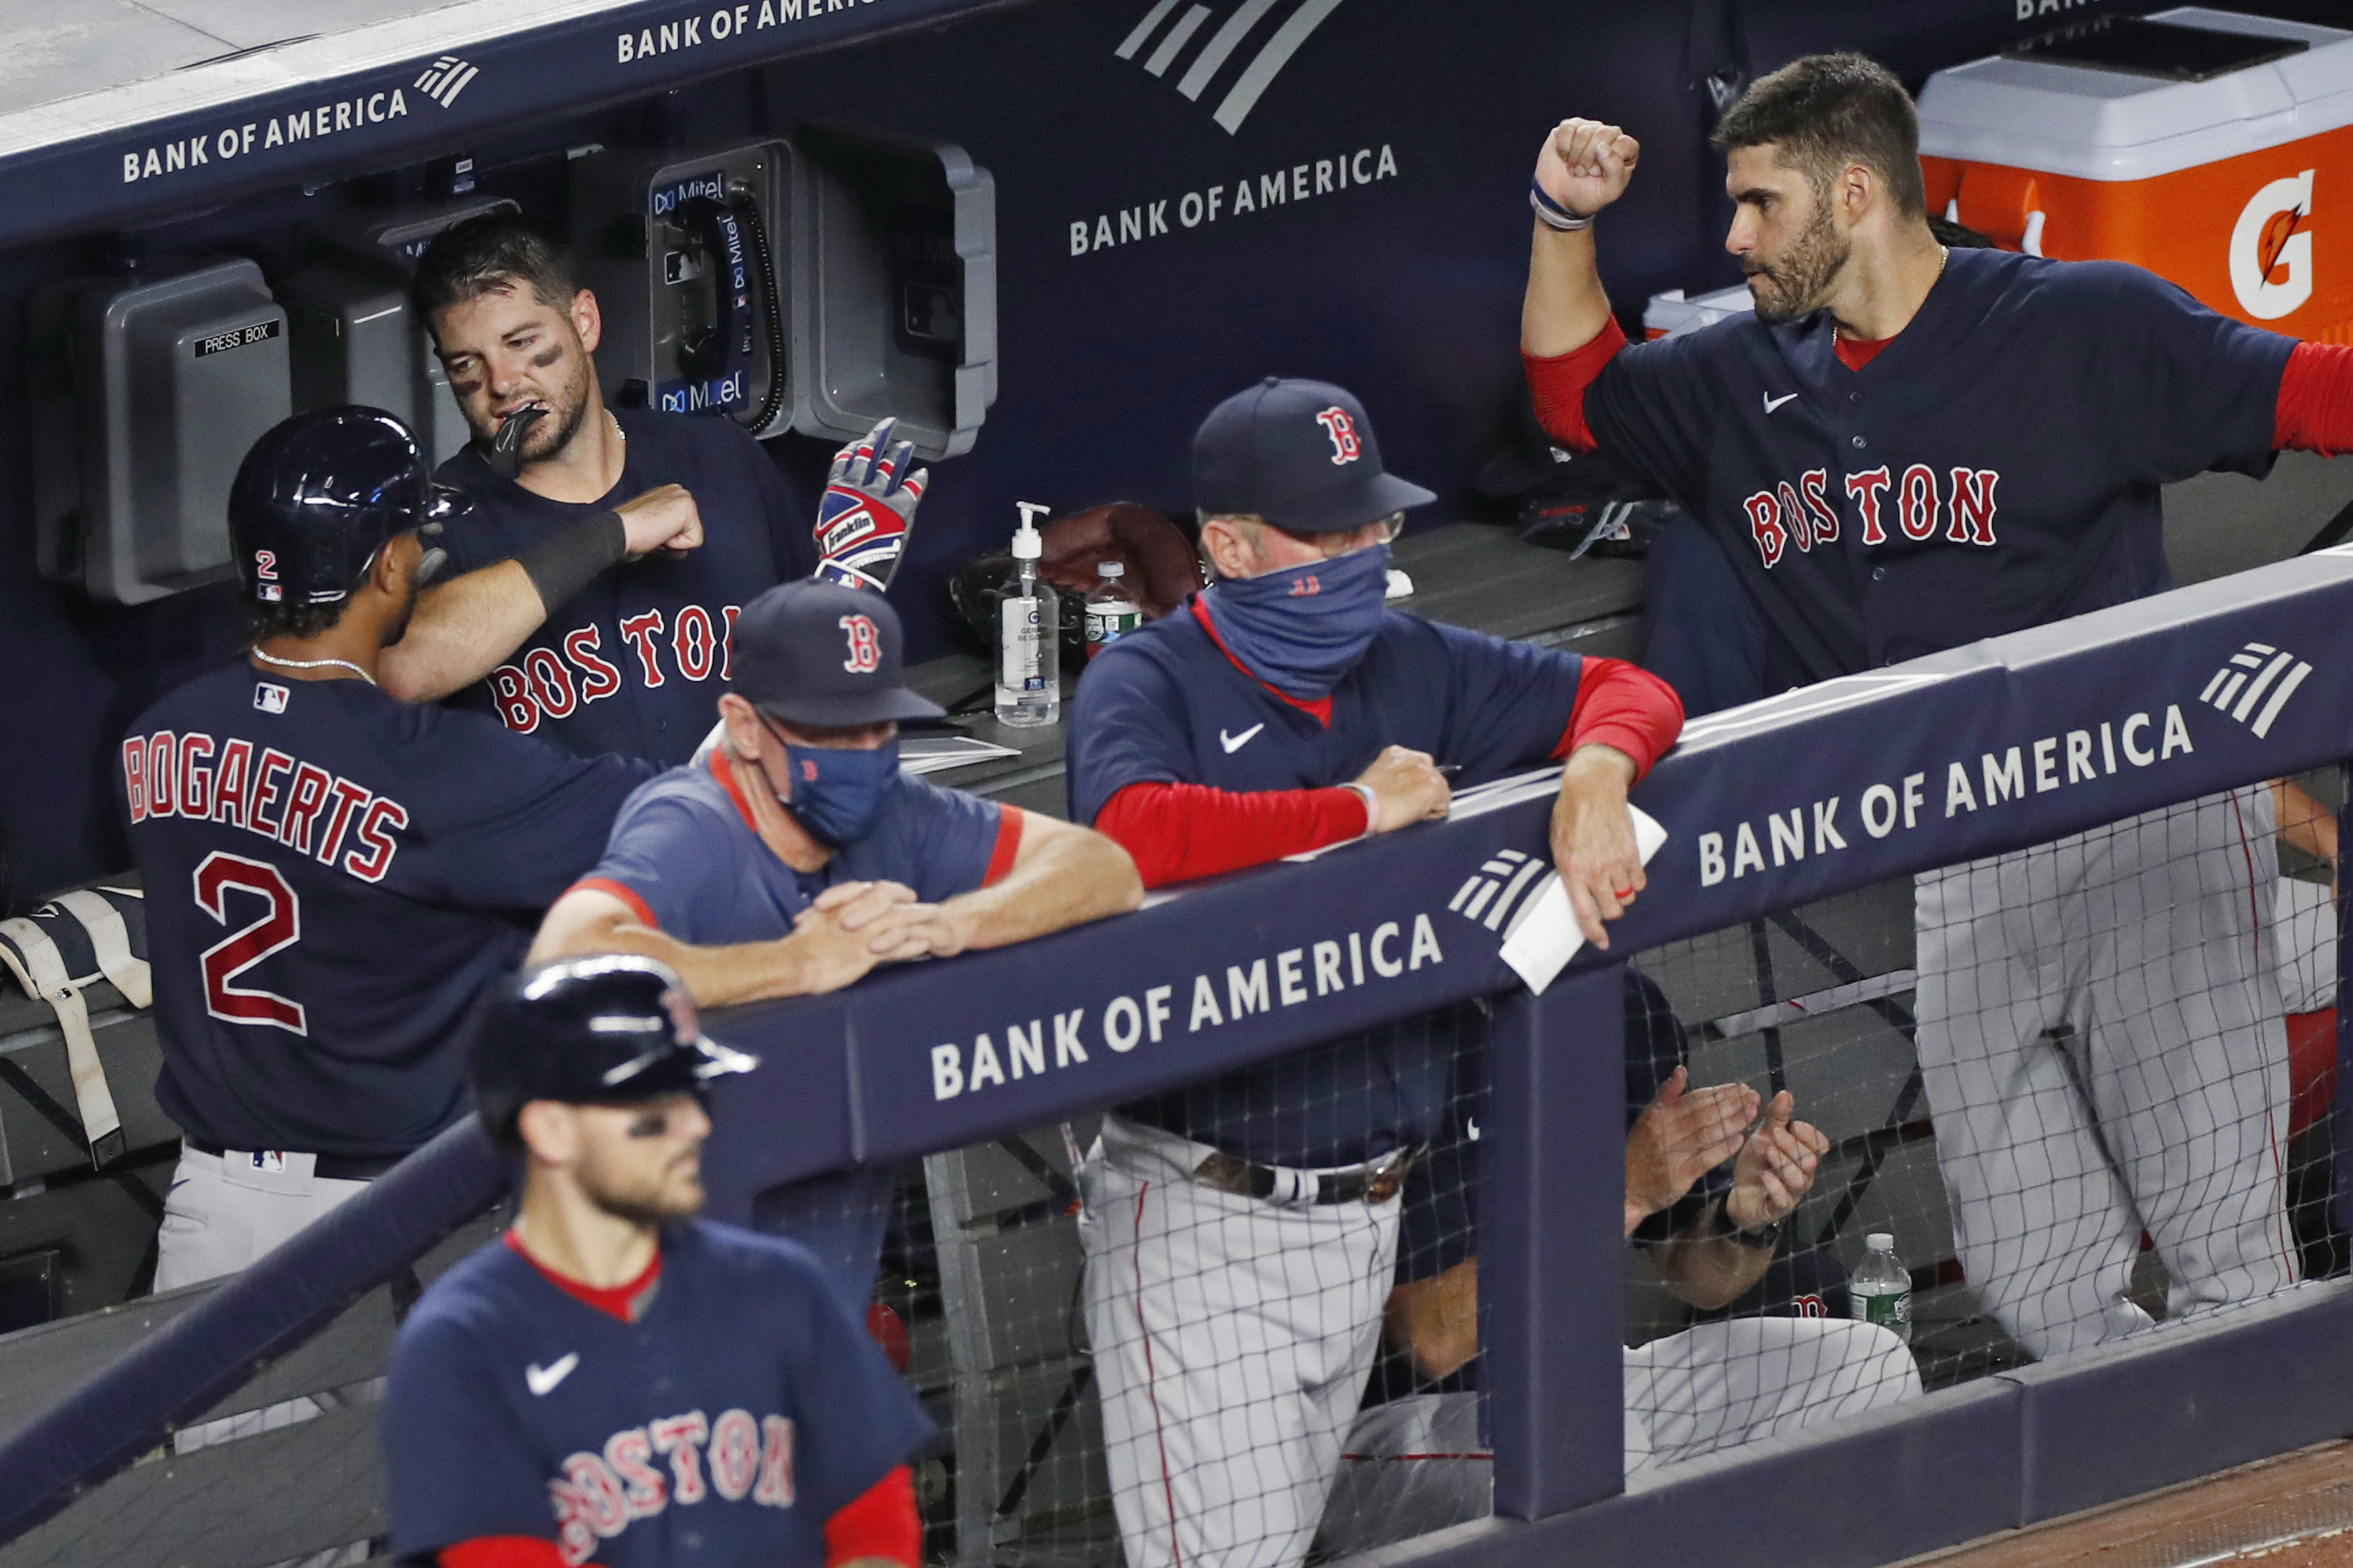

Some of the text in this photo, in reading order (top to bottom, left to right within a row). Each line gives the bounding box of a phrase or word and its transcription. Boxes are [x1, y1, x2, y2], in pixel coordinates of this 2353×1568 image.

[617, 16, 703, 64] BANK
[710, 4, 749, 40] OF
[123, 88, 408, 183] BANK OF AMERICA
[678, 173, 723, 202] Mitel
[1069, 144, 1398, 256] BANK OF AMERICA
[721, 215, 743, 265] Mitel
[2229, 168, 2316, 320] G
[205, 324, 269, 353] PRESS BOX
[690, 370, 743, 411] Mel
[1316, 406, 1362, 465] B
[1742, 463, 2000, 569] BOSTON
[256, 550, 279, 580] 2
[839, 614, 882, 673] B
[123, 729, 409, 884] BOGAERTS
[1699, 704, 2194, 888] BANK OF AMERICA
[192, 850, 308, 1037] 2
[931, 913, 1444, 1102] BANK OF AMERICA
